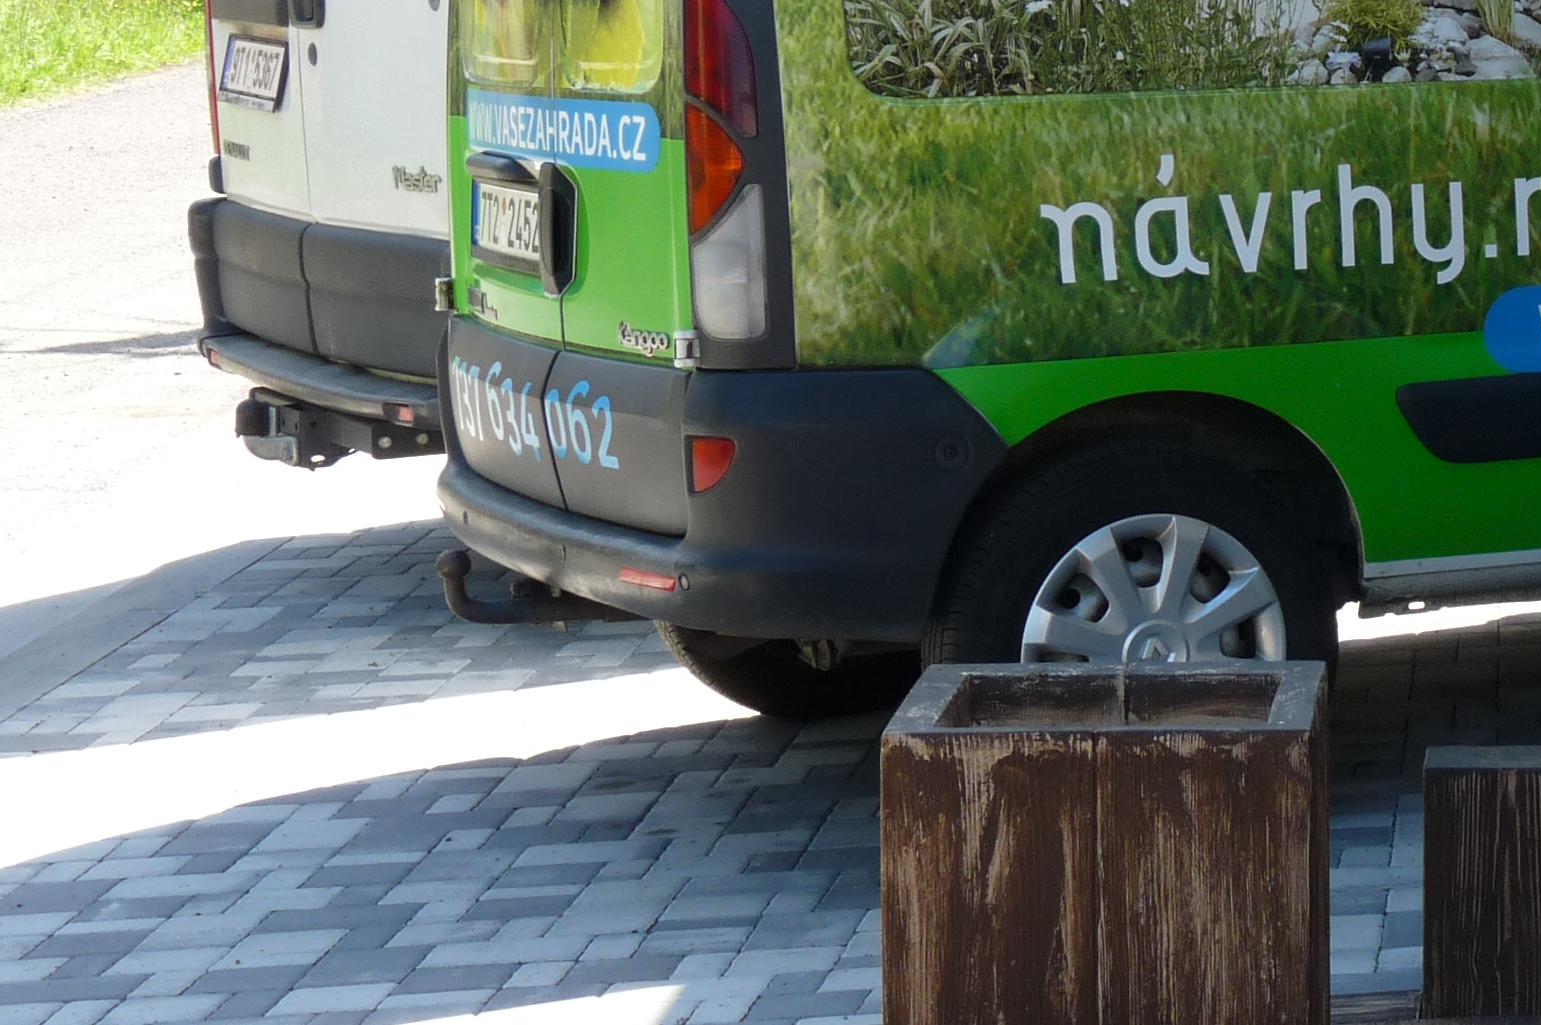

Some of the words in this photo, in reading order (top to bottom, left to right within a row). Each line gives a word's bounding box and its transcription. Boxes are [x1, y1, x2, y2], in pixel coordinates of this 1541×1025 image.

[469, 100, 647, 162] WWW.VASEZAHRADA.CZ
[481, 190, 499, 245] 7T2
[507, 195, 540, 254] 2452
[617, 320, 669, 357] Kangoo
[452, 355, 484, 442] 737
[484, 360, 542, 464] 634
[544, 379, 620, 470] 062
